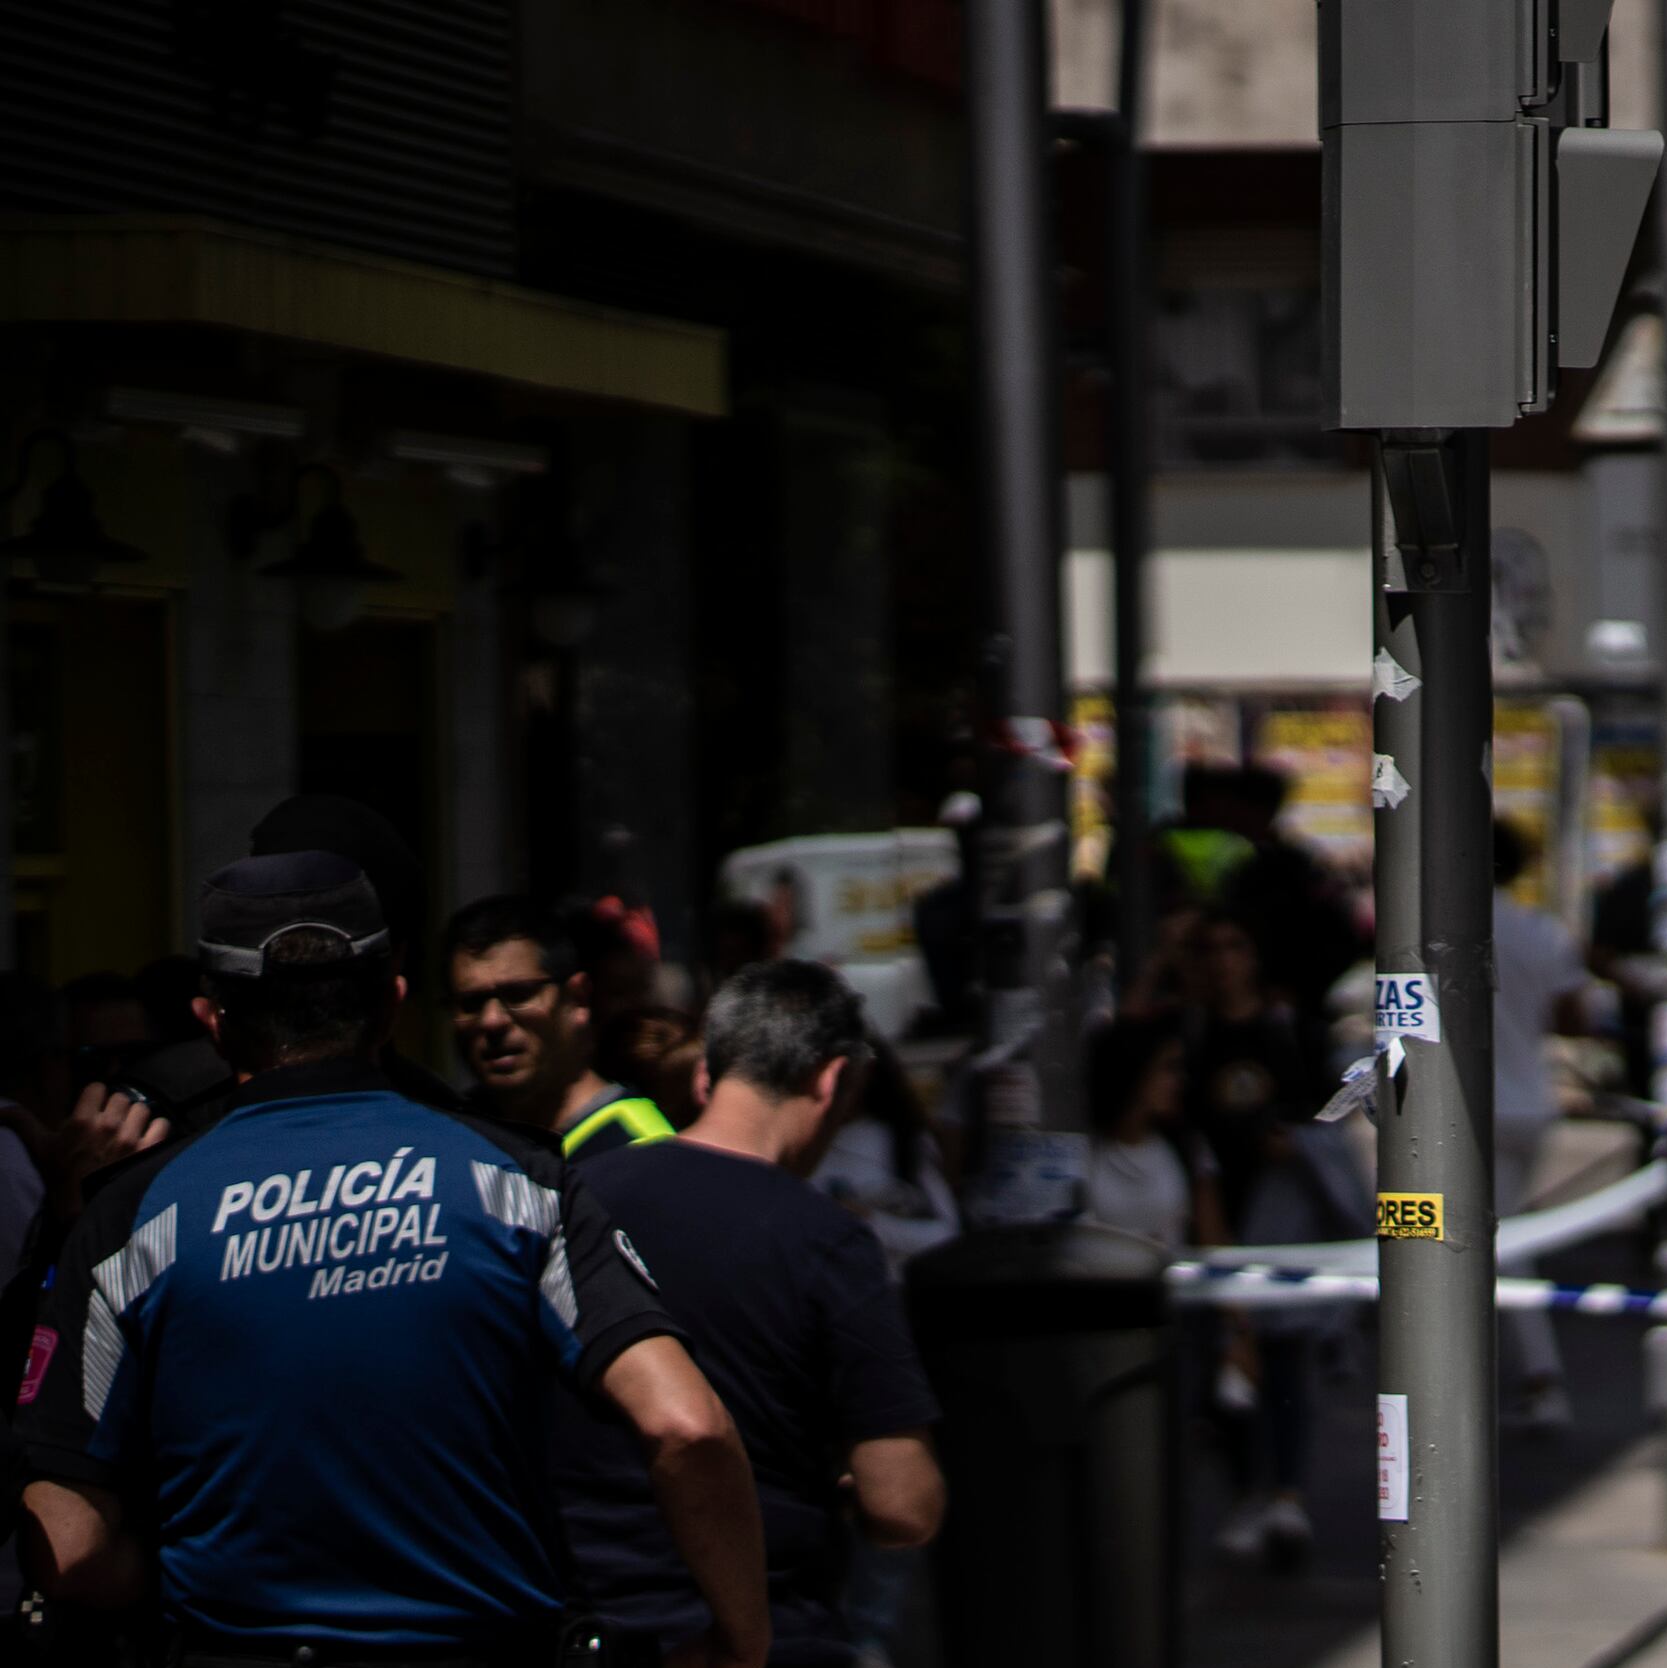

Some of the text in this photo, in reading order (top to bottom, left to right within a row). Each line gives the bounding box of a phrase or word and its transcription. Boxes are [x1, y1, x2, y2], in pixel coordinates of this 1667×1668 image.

[210, 1146, 437, 1235] POLICÍA
[219, 1203, 448, 1283] MUNICIPAL
[307, 1251, 450, 1301] Madrid
